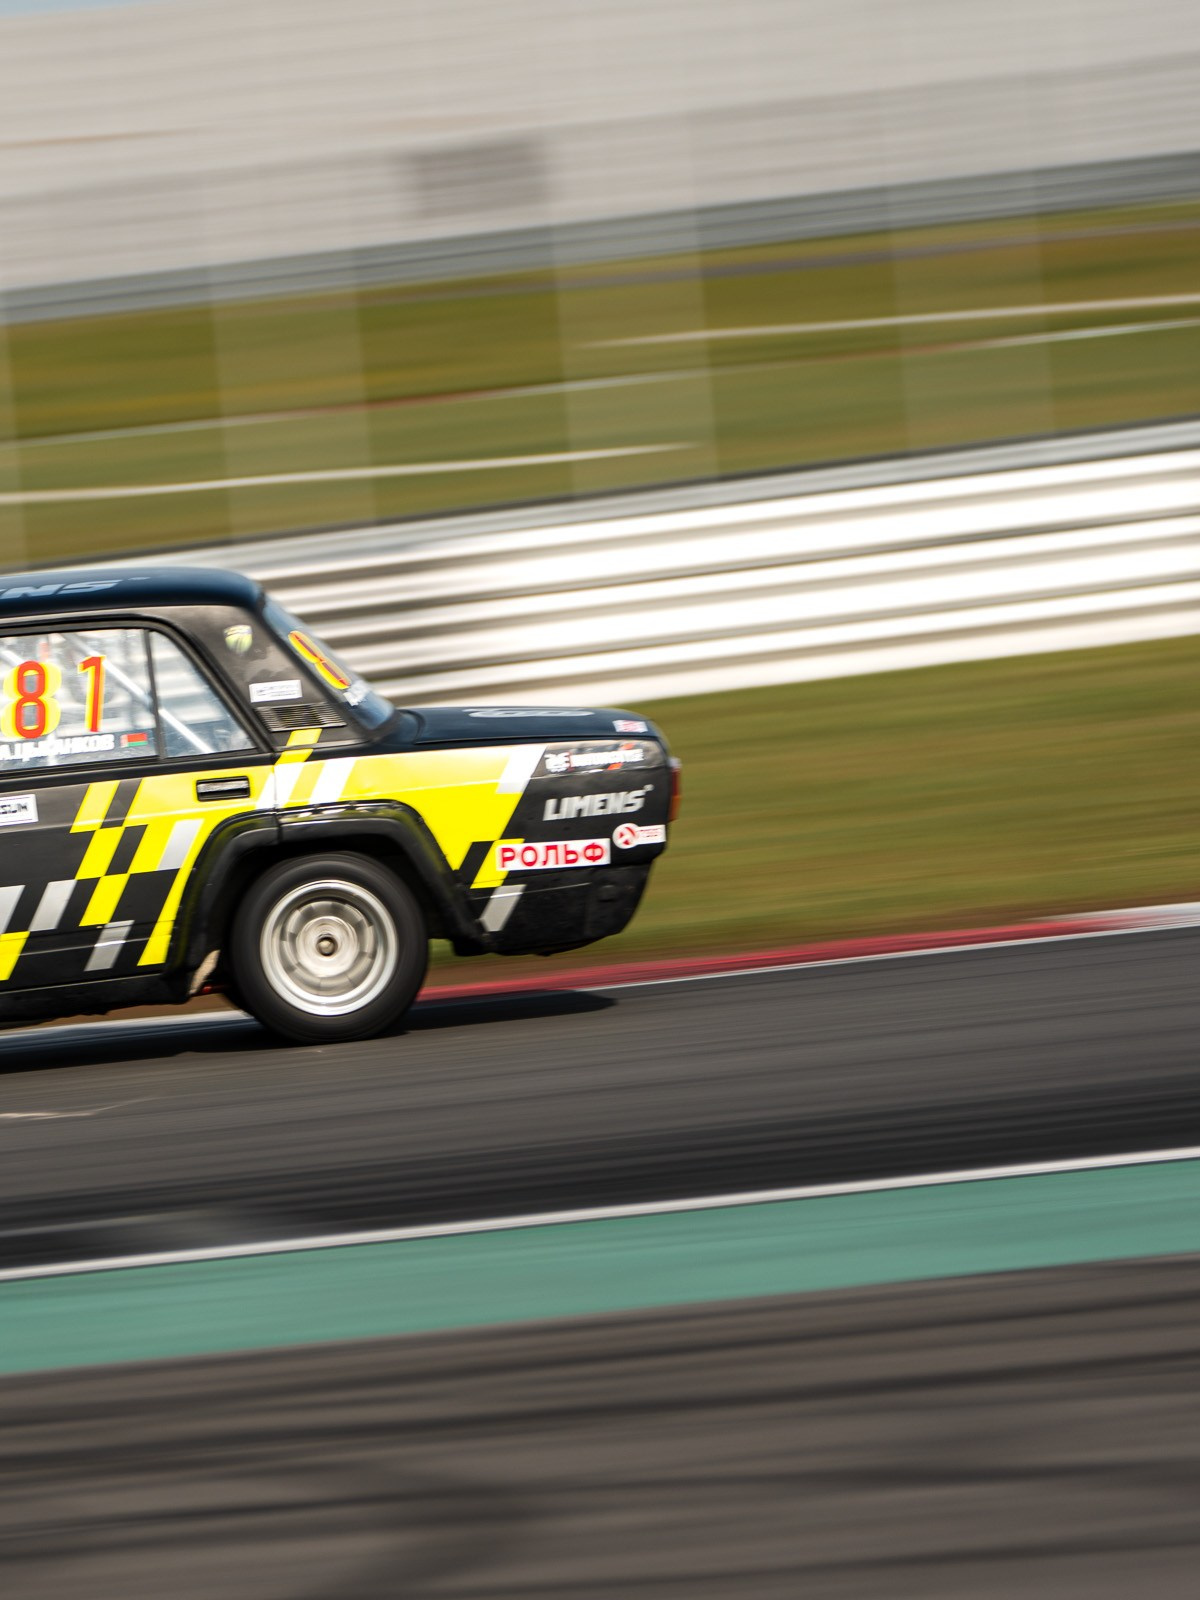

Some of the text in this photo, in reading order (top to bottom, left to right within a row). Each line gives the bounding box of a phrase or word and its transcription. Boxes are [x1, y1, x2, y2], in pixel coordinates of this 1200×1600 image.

[0, 655, 106, 739] 81
[542, 789, 647, 822] LIMENS
[500, 842, 605, 868] РОЛЬФ
